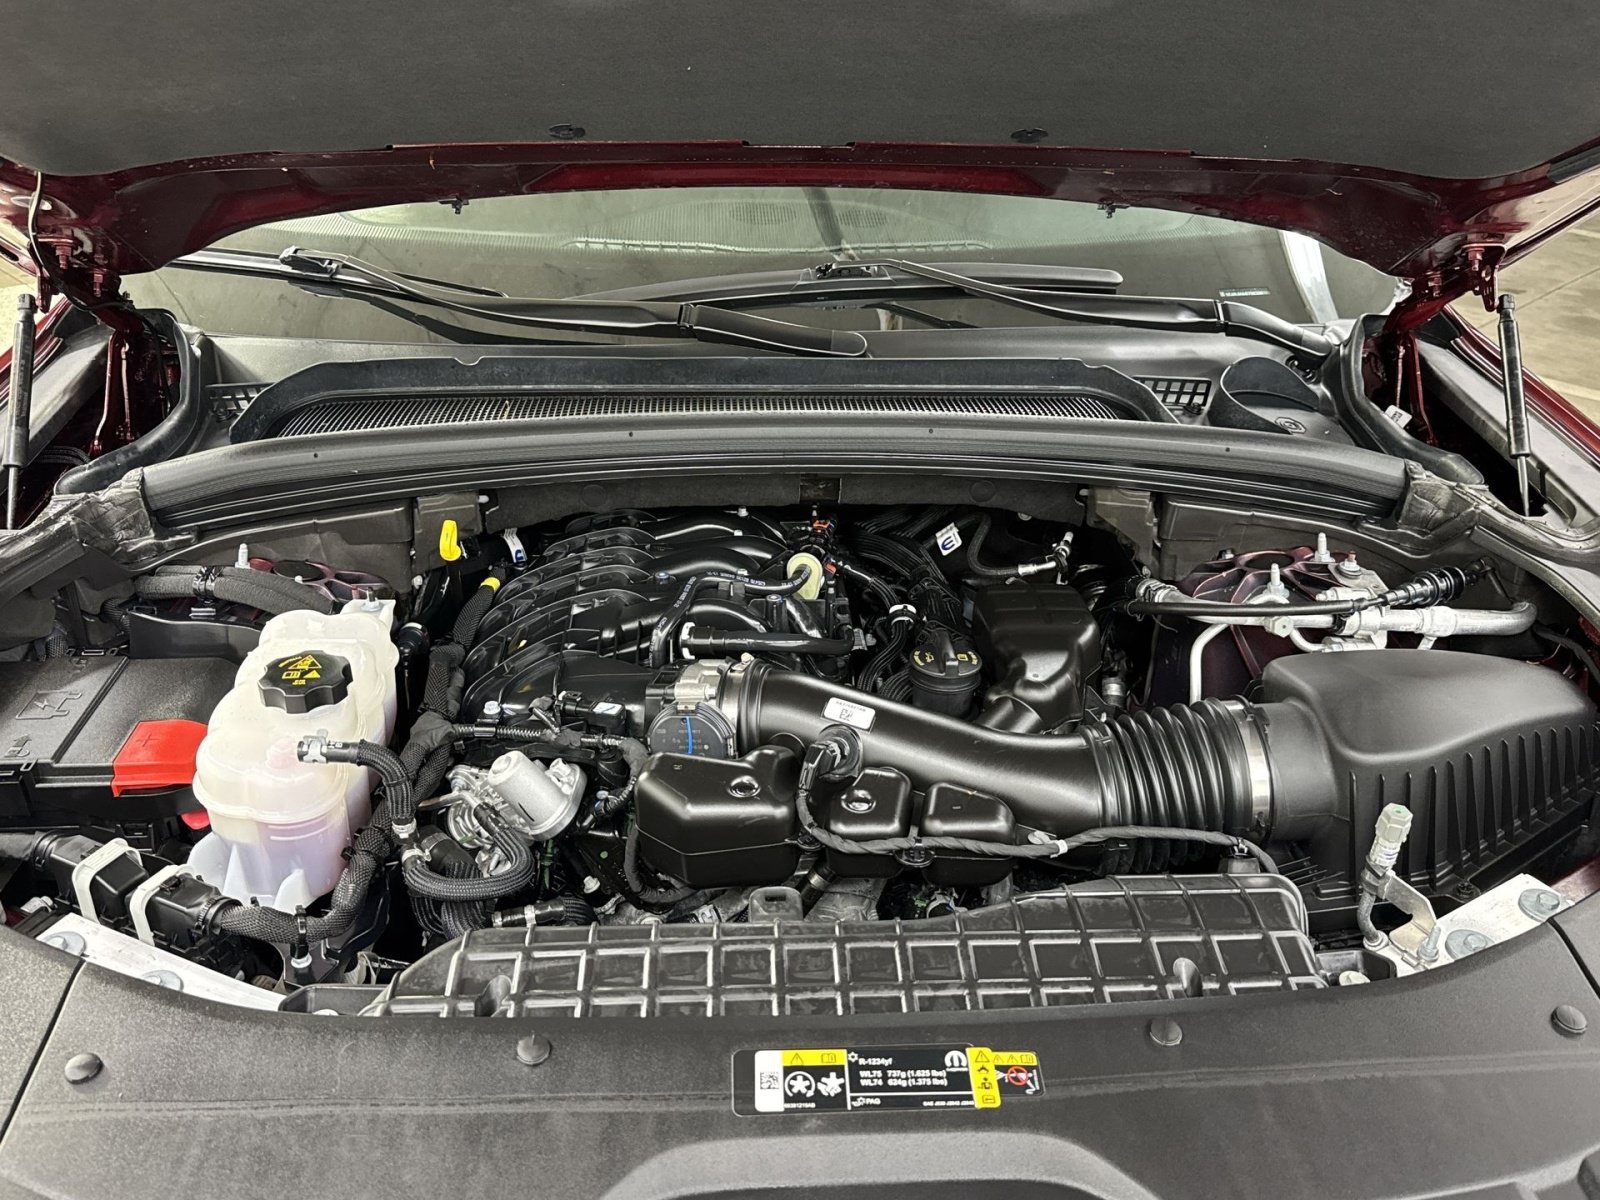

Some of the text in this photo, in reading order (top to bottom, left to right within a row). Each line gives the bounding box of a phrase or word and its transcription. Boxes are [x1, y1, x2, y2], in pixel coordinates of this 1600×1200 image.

[859, 1070, 883, 1078] WL75
[886, 1070, 907, 1079] 737g
[860, 1078, 884, 1086] WL74
[887, 1078, 908, 1087] 624g
